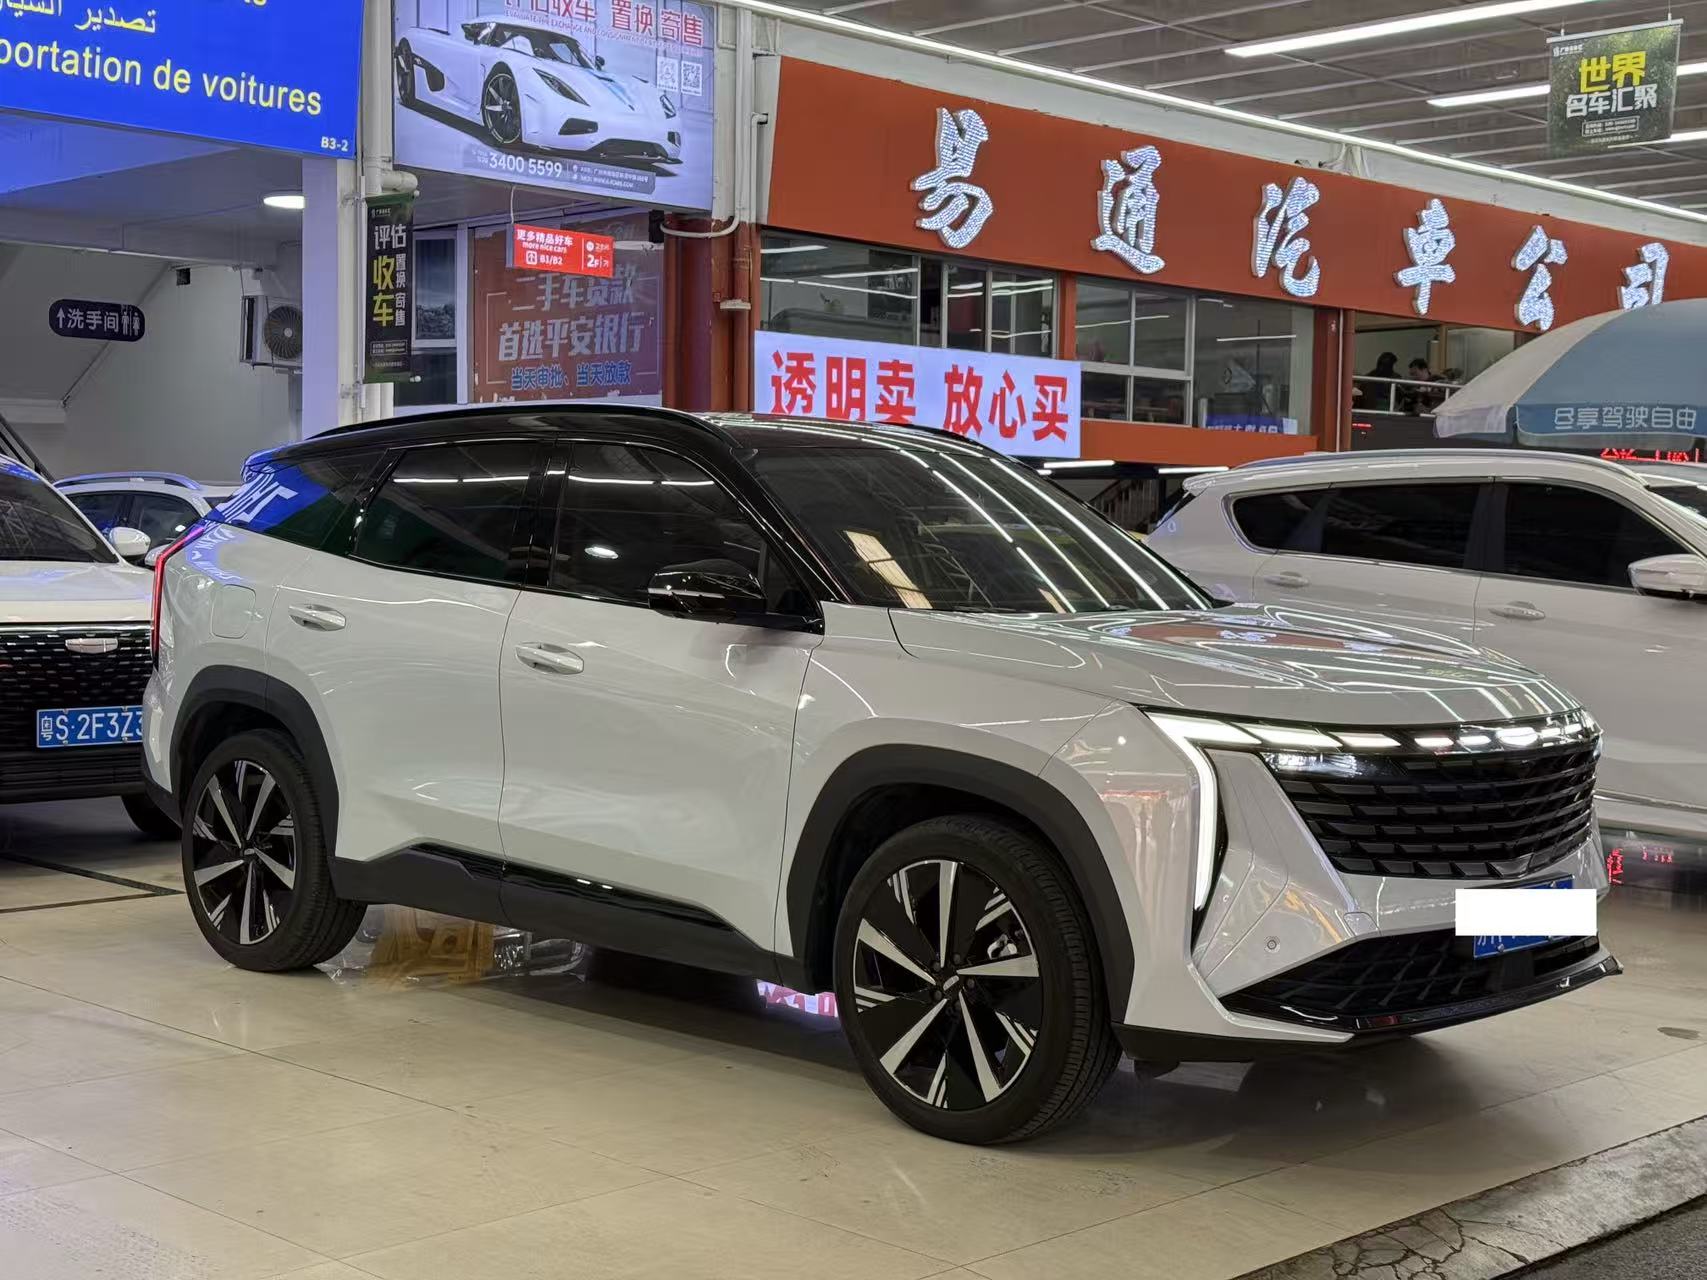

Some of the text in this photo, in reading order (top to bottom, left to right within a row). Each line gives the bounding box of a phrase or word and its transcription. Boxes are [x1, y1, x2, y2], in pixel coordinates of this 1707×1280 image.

[611, 0, 653, 34] 置换
[1579, 51, 1646, 93] 世界
[153, 59, 192, 94] de
[202, 72, 322, 116] voitures
[1566, 84, 1658, 118] 名车汇聚
[320, 136, 349, 152] B3-2
[489, 152, 525, 173] 3400
[528, 159, 563, 178] 5599
[374, 224, 407, 250] 评估
[517, 229, 573, 247] 更多精品好车
[522, 241, 539, 250] more
[373, 255, 395, 327] 收车
[67, 308, 119, 333] 洗手间
[498, 312, 645, 361] 首选平安银行
[771, 350, 1069, 442] 透明卖 放心买
[1554, 406, 1697, 430] 尽享驾驶自由
